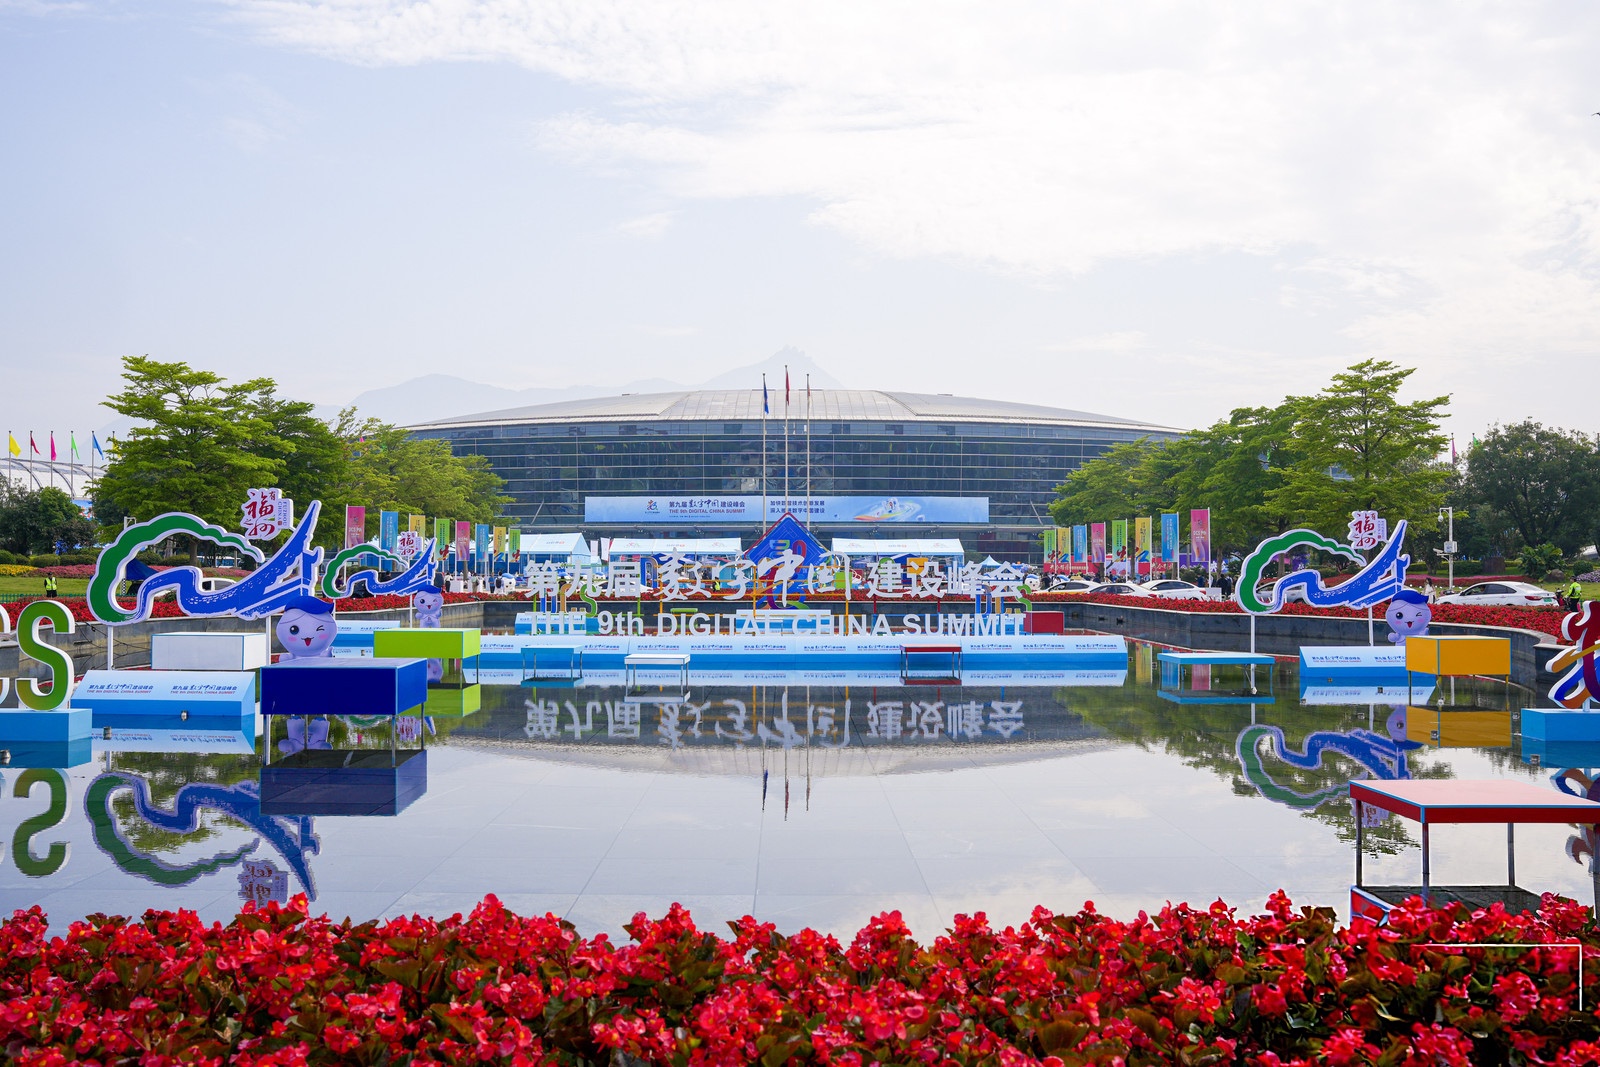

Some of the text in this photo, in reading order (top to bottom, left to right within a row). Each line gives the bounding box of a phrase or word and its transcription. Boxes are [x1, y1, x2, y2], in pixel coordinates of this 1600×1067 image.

[525, 610, 1026, 636] THE 9th DIGITAL CHINA SUMMIT
